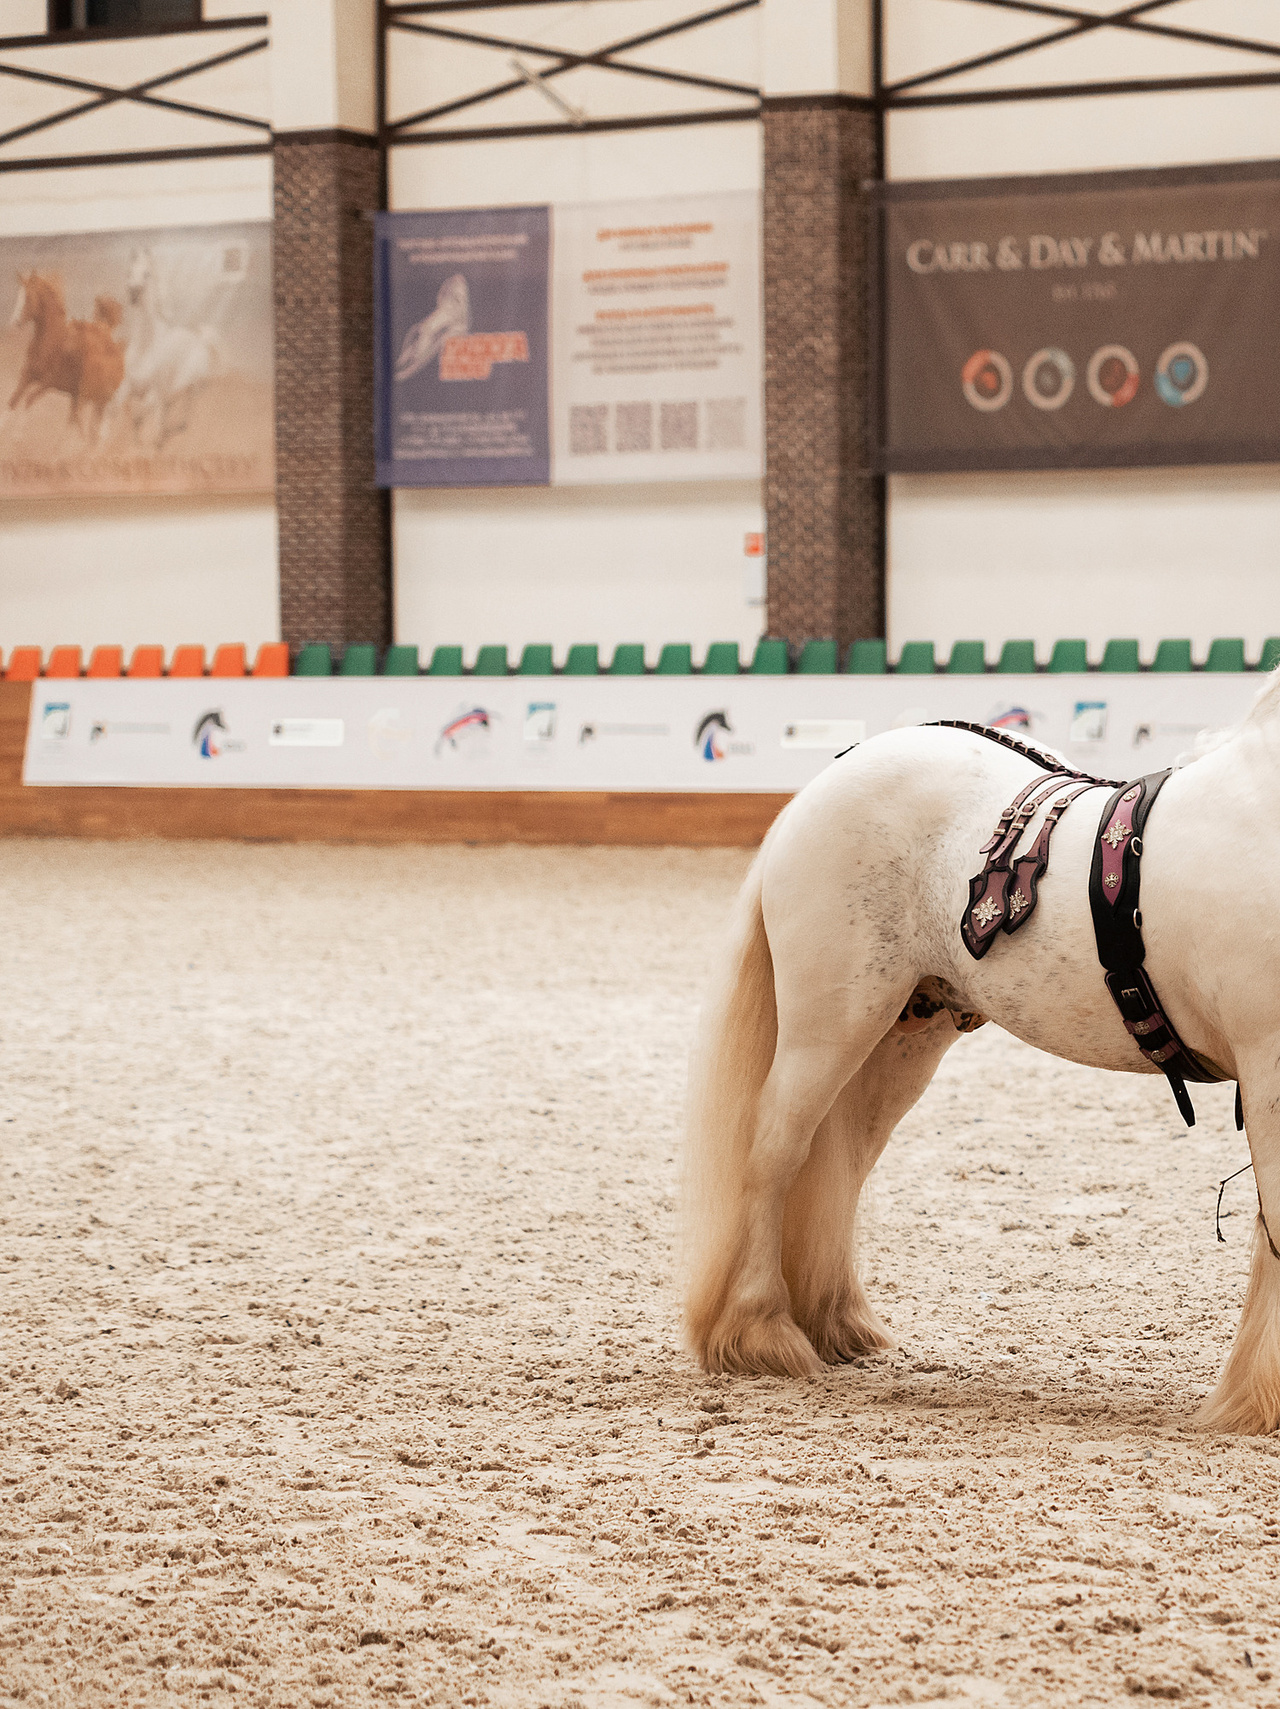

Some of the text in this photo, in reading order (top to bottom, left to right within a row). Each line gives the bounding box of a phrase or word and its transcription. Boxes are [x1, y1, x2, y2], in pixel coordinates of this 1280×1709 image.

[906, 239, 991, 274] CARR
[996, 236, 1024, 270] &
[1027, 234, 1094, 269] DAY
[1098, 231, 1127, 266] &
